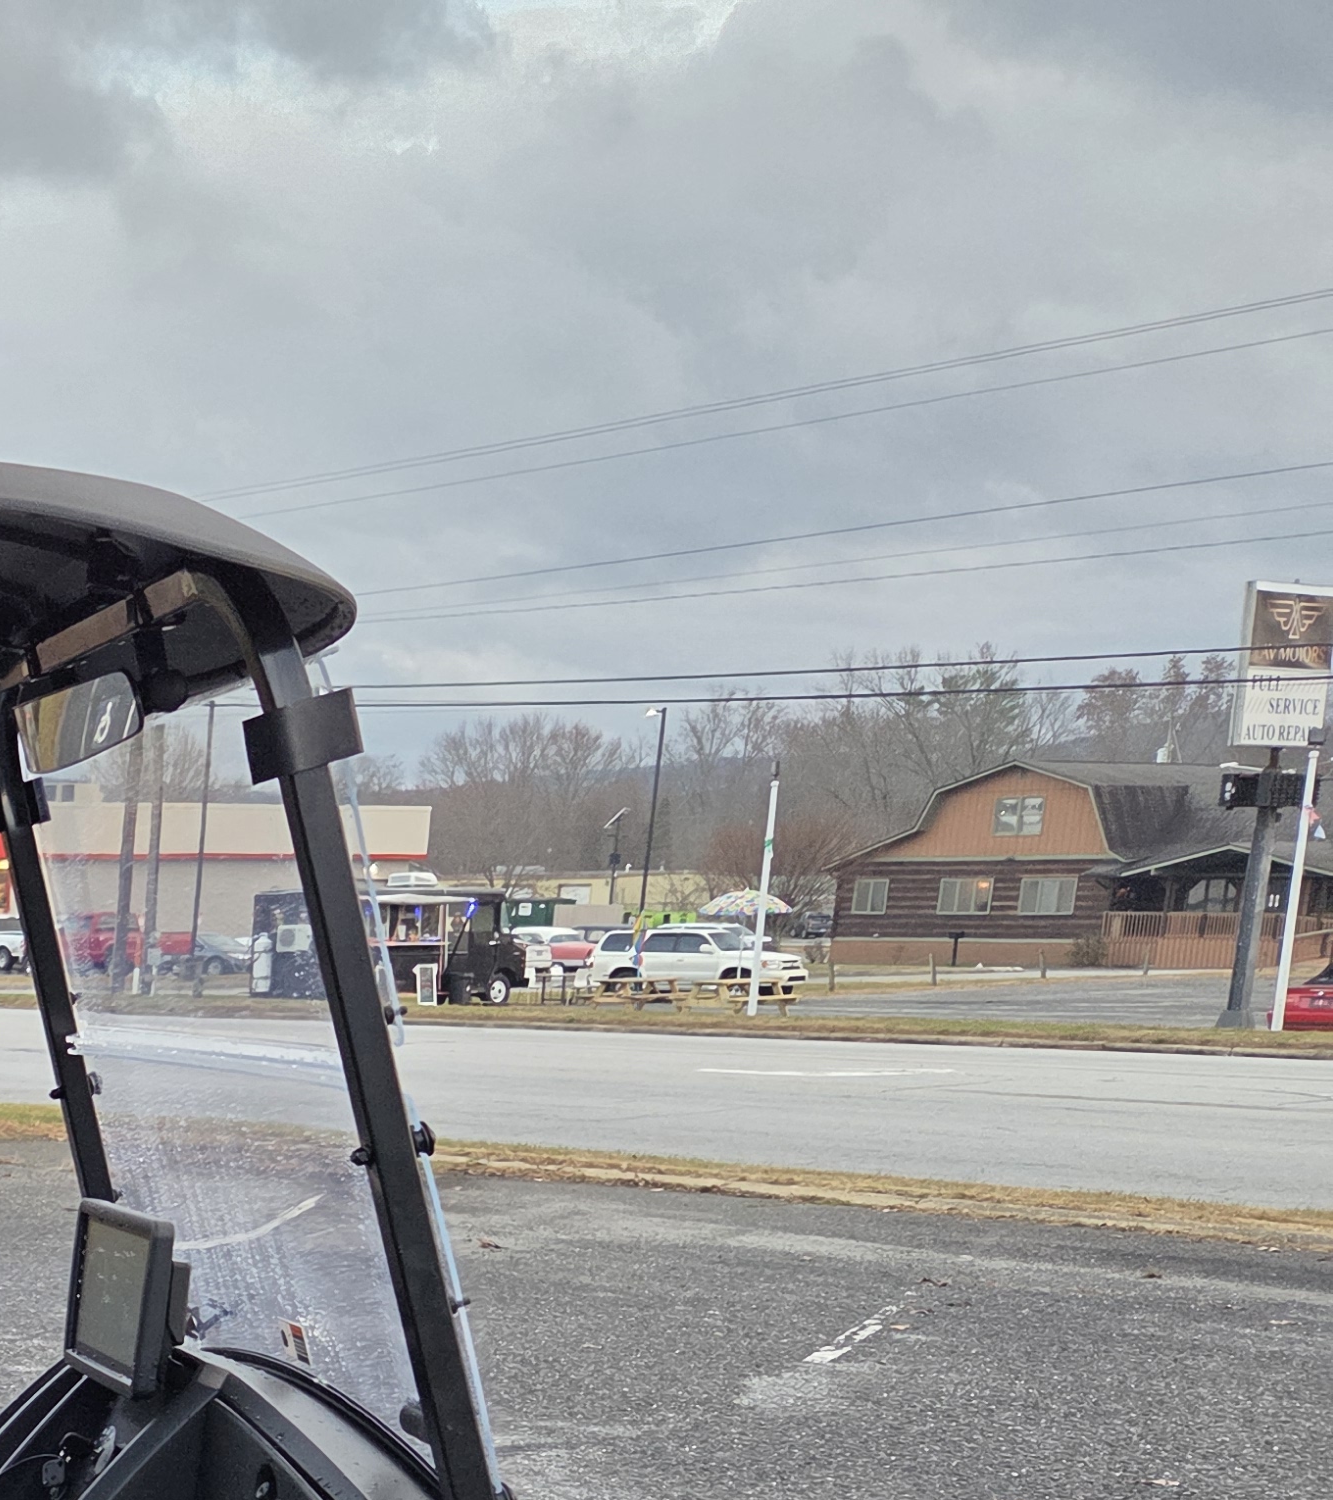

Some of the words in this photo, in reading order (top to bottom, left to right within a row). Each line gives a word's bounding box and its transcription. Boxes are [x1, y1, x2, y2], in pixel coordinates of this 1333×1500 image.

[1252, 674, 1283, 692] FULL
[1267, 697, 1321, 716] SERVICE
[1243, 723, 1276, 741] AUTO
[1277, 724, 1311, 742] REPA
